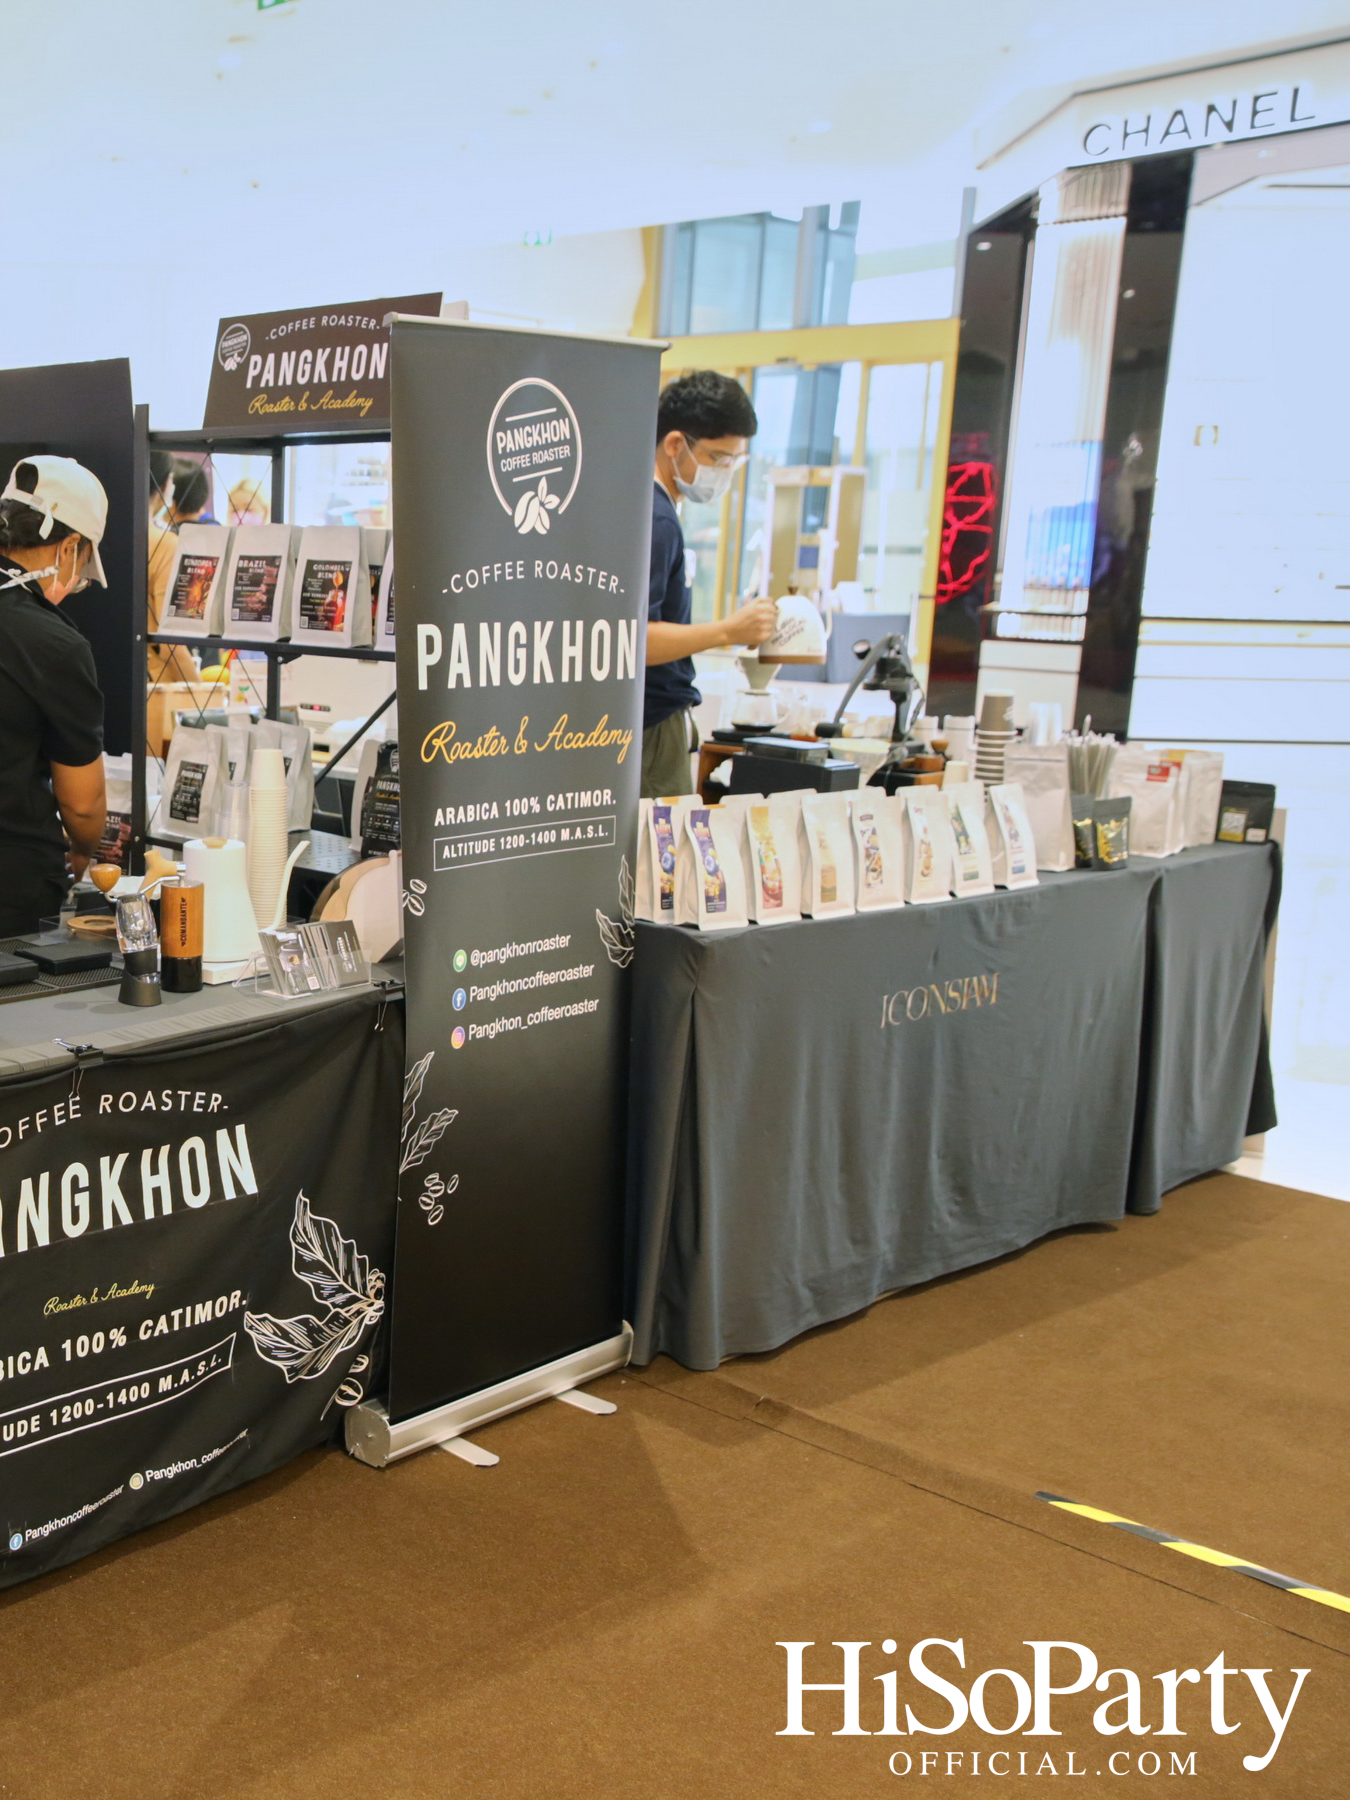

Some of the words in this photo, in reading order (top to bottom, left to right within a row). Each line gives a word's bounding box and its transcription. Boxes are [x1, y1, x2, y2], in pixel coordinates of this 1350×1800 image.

[1082, 87, 1316, 156] CHANEL
[246, 342, 389, 389] PANGKHON
[248, 393, 296, 415] Roaster
[310, 389, 374, 417] Academy
[496, 417, 571, 455] PANGKHON
[500, 453, 531, 473] COFFEE
[532, 445, 571, 466] ROASTER
[238, 560, 266, 568] BRAZIL
[417, 618, 638, 691] PANGKHON
[420, 720, 510, 764] Roaster
[514, 715, 529, 753] &
[534, 713, 633, 765] Academy
[434, 801, 500, 827] ARABICA
[504, 797, 541, 817] 100%
[442, 838, 496, 860] ALTITUDE
[499, 829, 557, 850] 1200-1400
[560, 824, 609, 842] M.A.S.L.
[469, 933, 572, 968] @pangkhonroaster
[469, 963, 595, 1003] Pangkhoncoffeeroaster
[880, 971, 1000, 1029] ICONSIAM
[468, 998, 600, 1041] Pangkhon_coffeeroaster
[42, 1295, 87, 1317] Roaster
[89, 1288, 99, 1305] &
[100, 1281, 156, 1302] Academy
[60, 1325, 128, 1361] 100%
[49, 1381, 151, 1427] 1200-1400
[158, 1354, 223, 1395] M.A.S.L.
